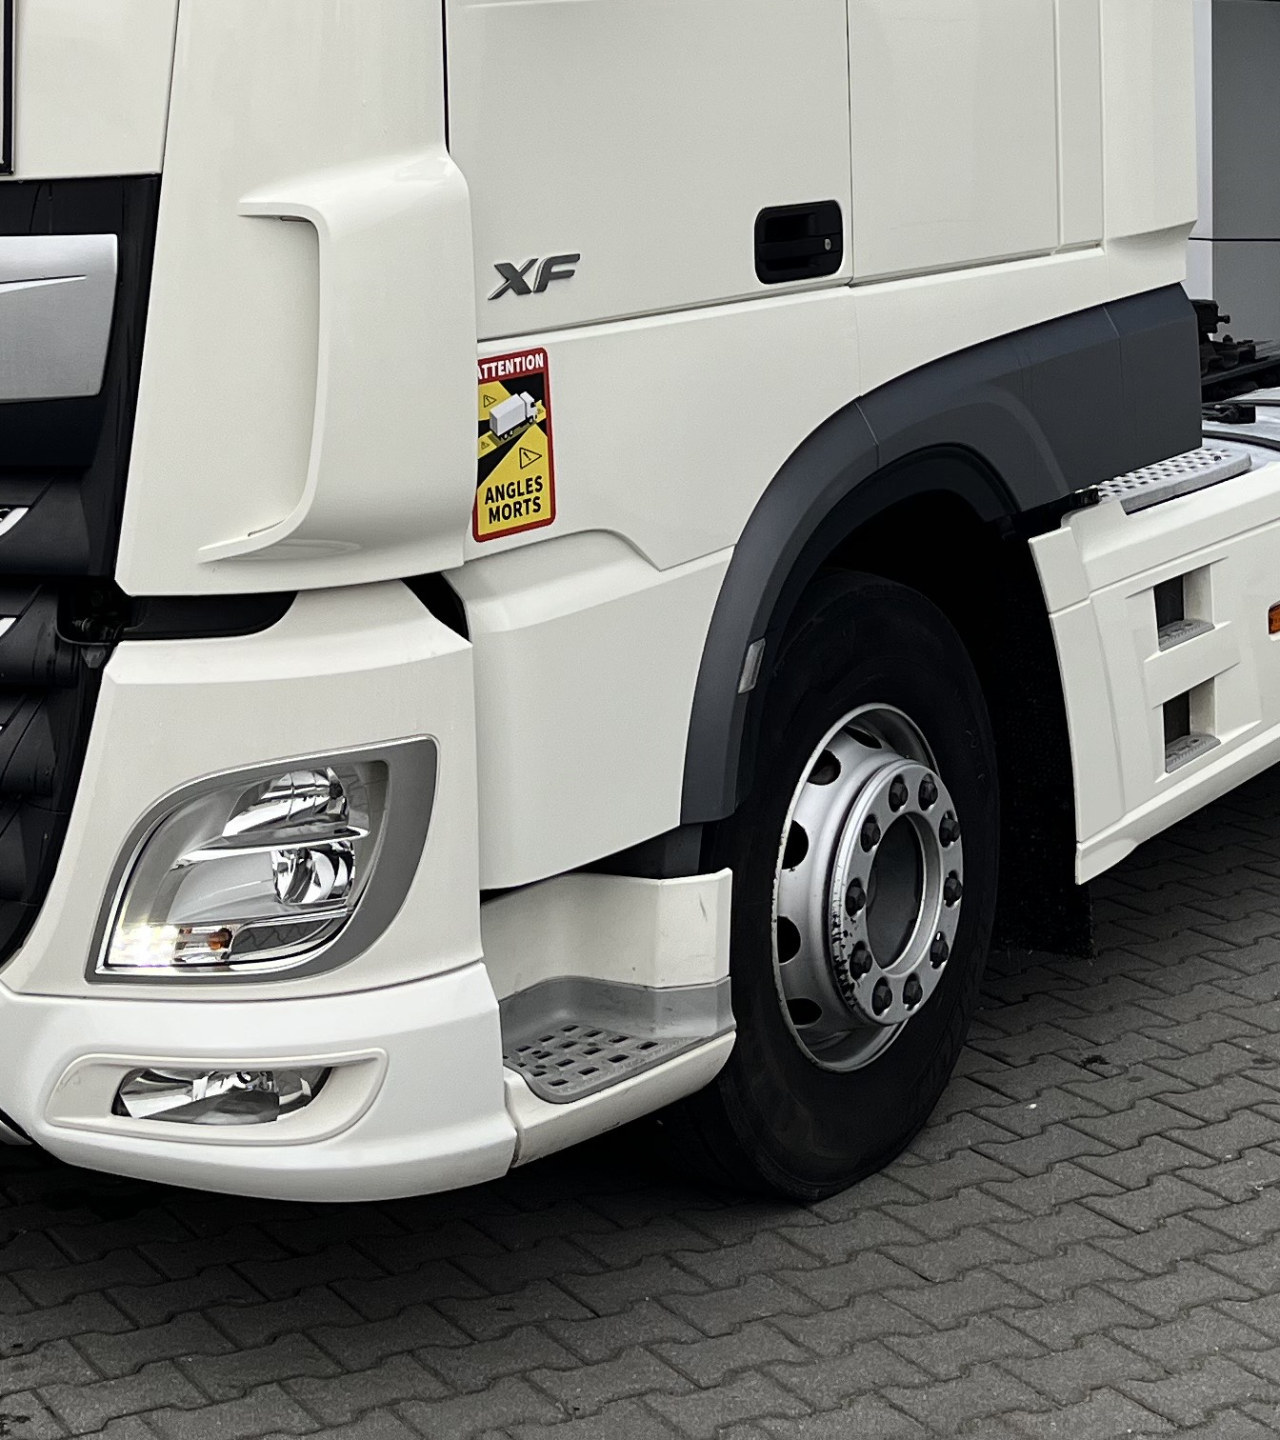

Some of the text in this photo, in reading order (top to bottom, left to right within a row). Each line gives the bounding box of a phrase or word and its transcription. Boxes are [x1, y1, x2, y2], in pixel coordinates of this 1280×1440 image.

[487, 252, 581, 301] XF
[484, 475, 544, 505] ANGLES
[488, 496, 542, 524] MORTS
